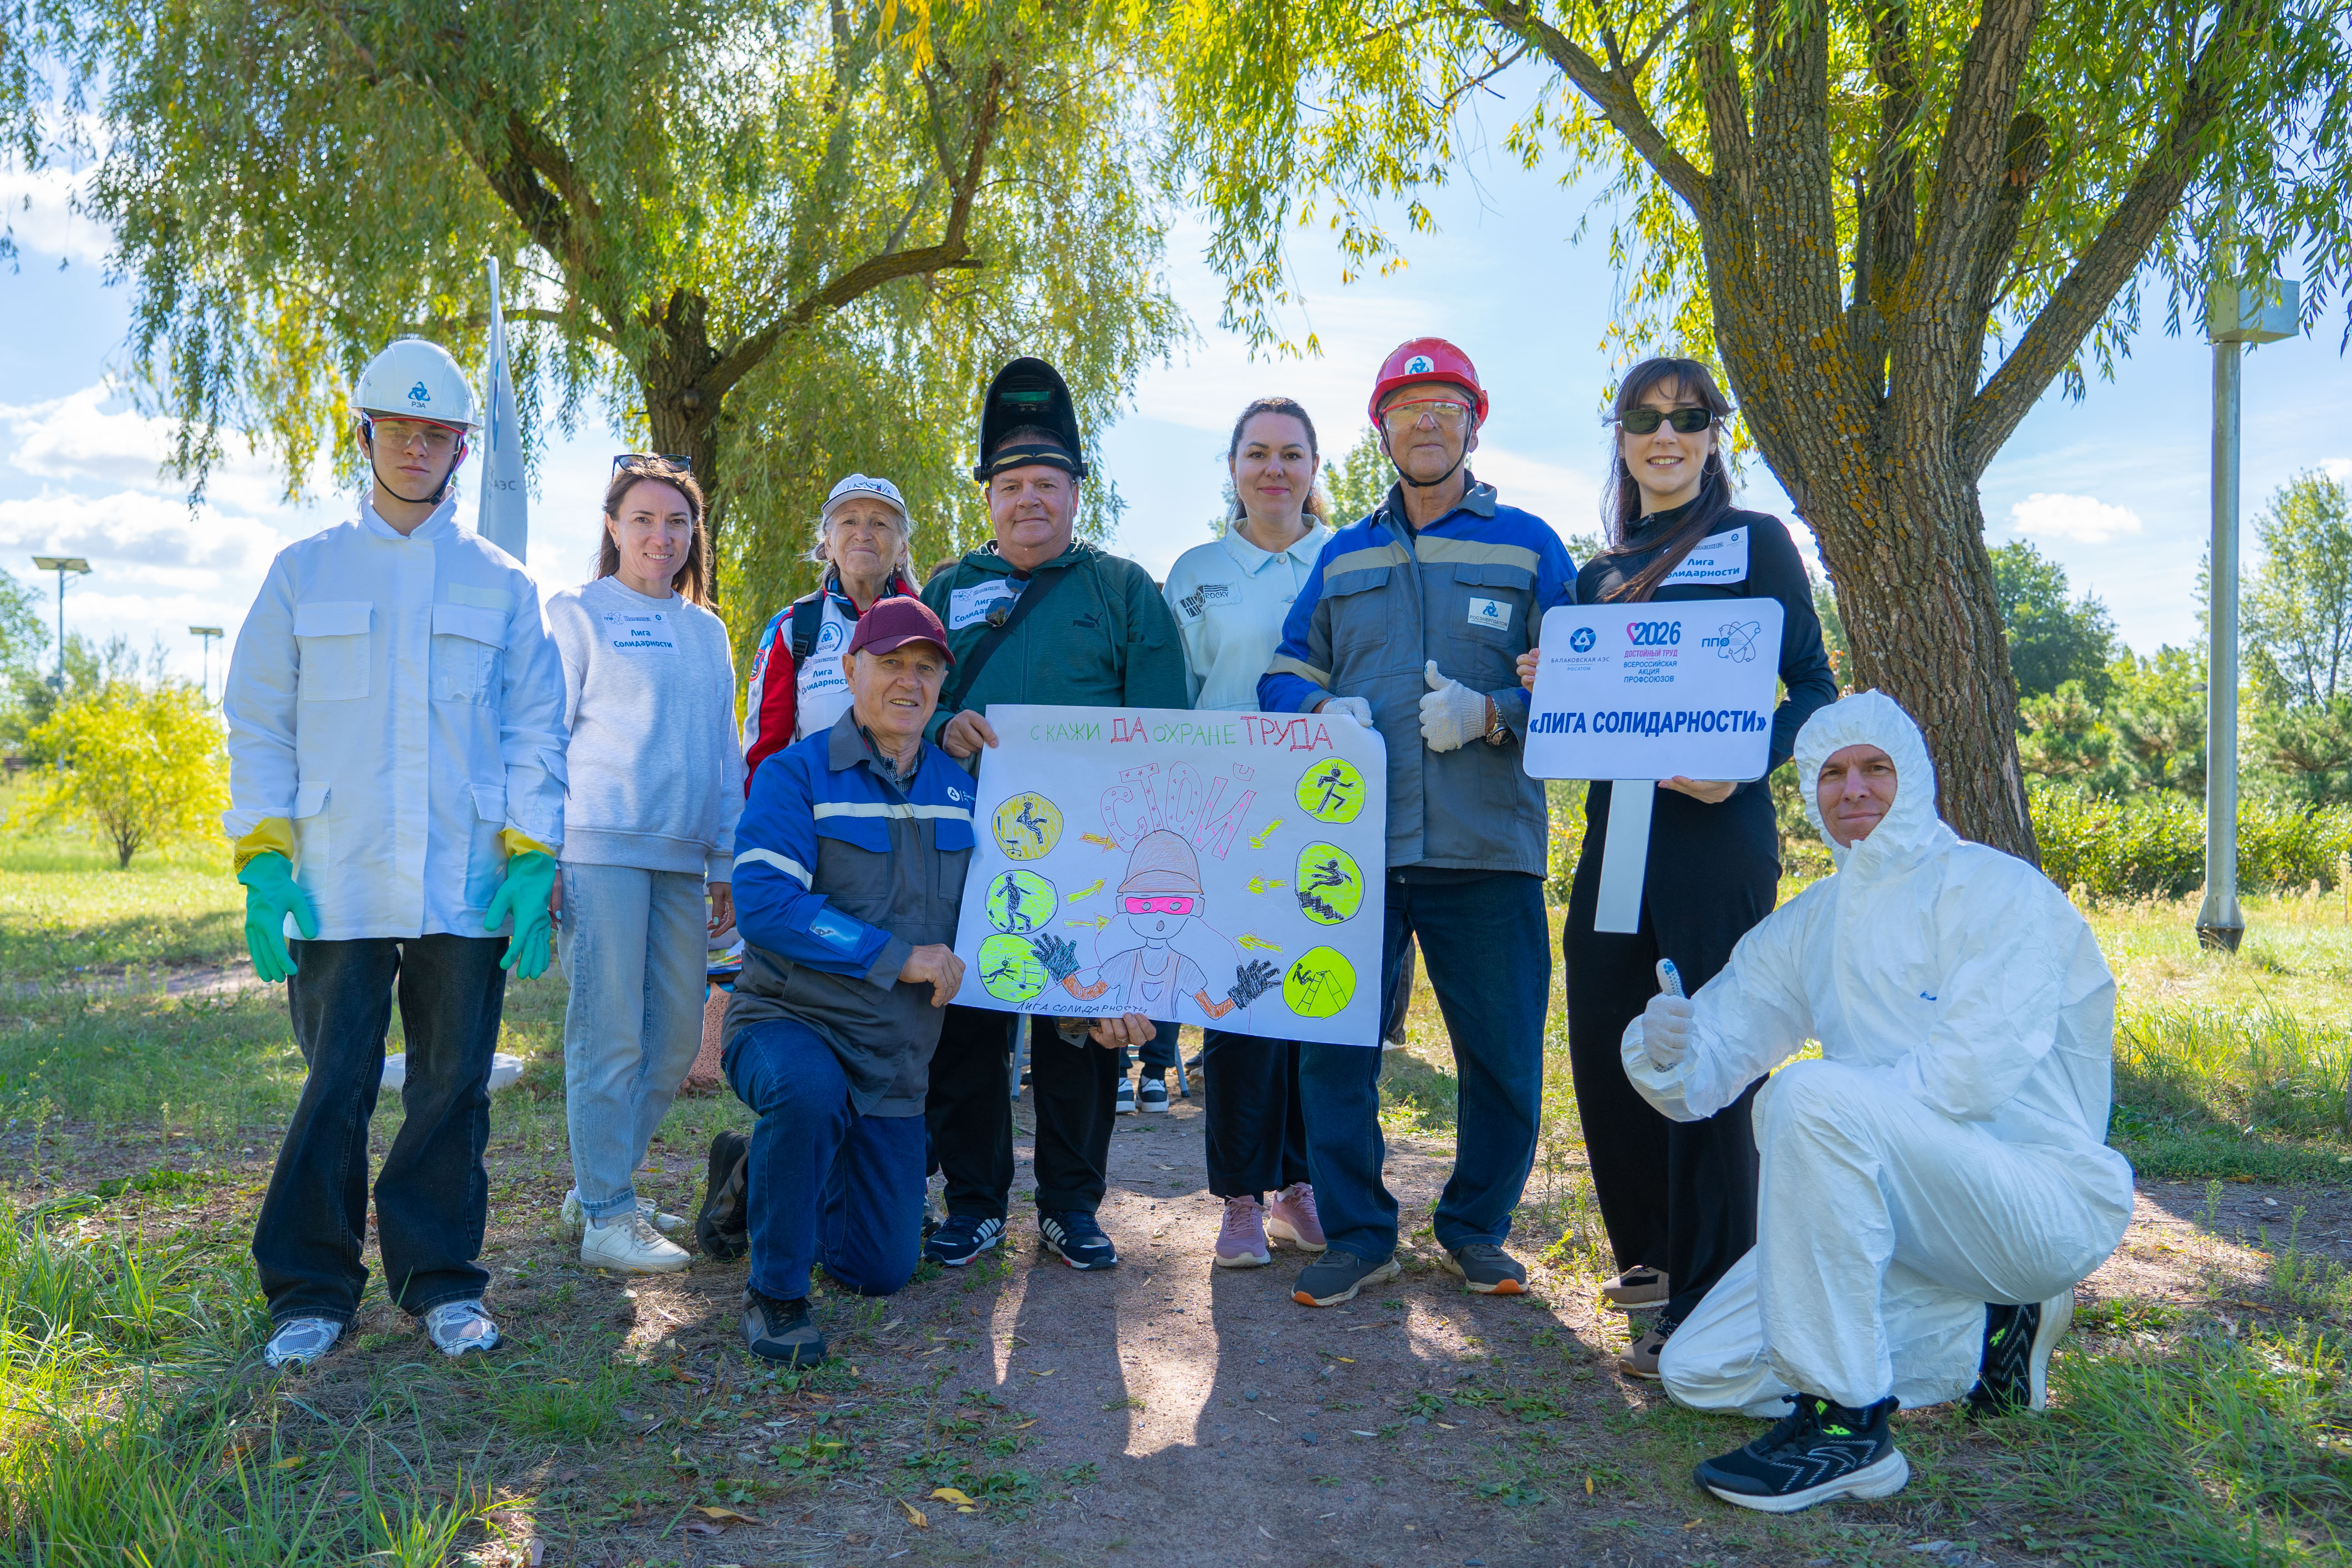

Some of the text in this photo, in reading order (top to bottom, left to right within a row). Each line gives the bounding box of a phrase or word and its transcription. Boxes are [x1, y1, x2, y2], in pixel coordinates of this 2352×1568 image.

[1666, 567, 1740, 578] олидарности
[1205, 591, 1229, 599] ROCKY
[974, 598, 995, 607] Лига
[1469, 615, 1508, 627] РОСЭНЕРГОАТОМ
[1632, 620, 1682, 645] 2026
[1624, 648, 1678, 658] ДОСТОЙНЫЙ ТРУД
[1623, 660, 1677, 668] ВСЕРОССИЙСКАЯ
[812, 669, 833, 678] Лига
[1529, 710, 1767, 738] «ЛИГА СОЛИДАРНОСТИ»
[1110, 716, 1148, 744] ДА
[1153, 722, 1236, 746] ОХРАНЕ
[1239, 715, 1333, 752] ТРУДА
[1100, 760, 1258, 861] СТОЙ
[1016, 1001, 1148, 1014] ЛИГА СОЛИДАРНОСТИ
